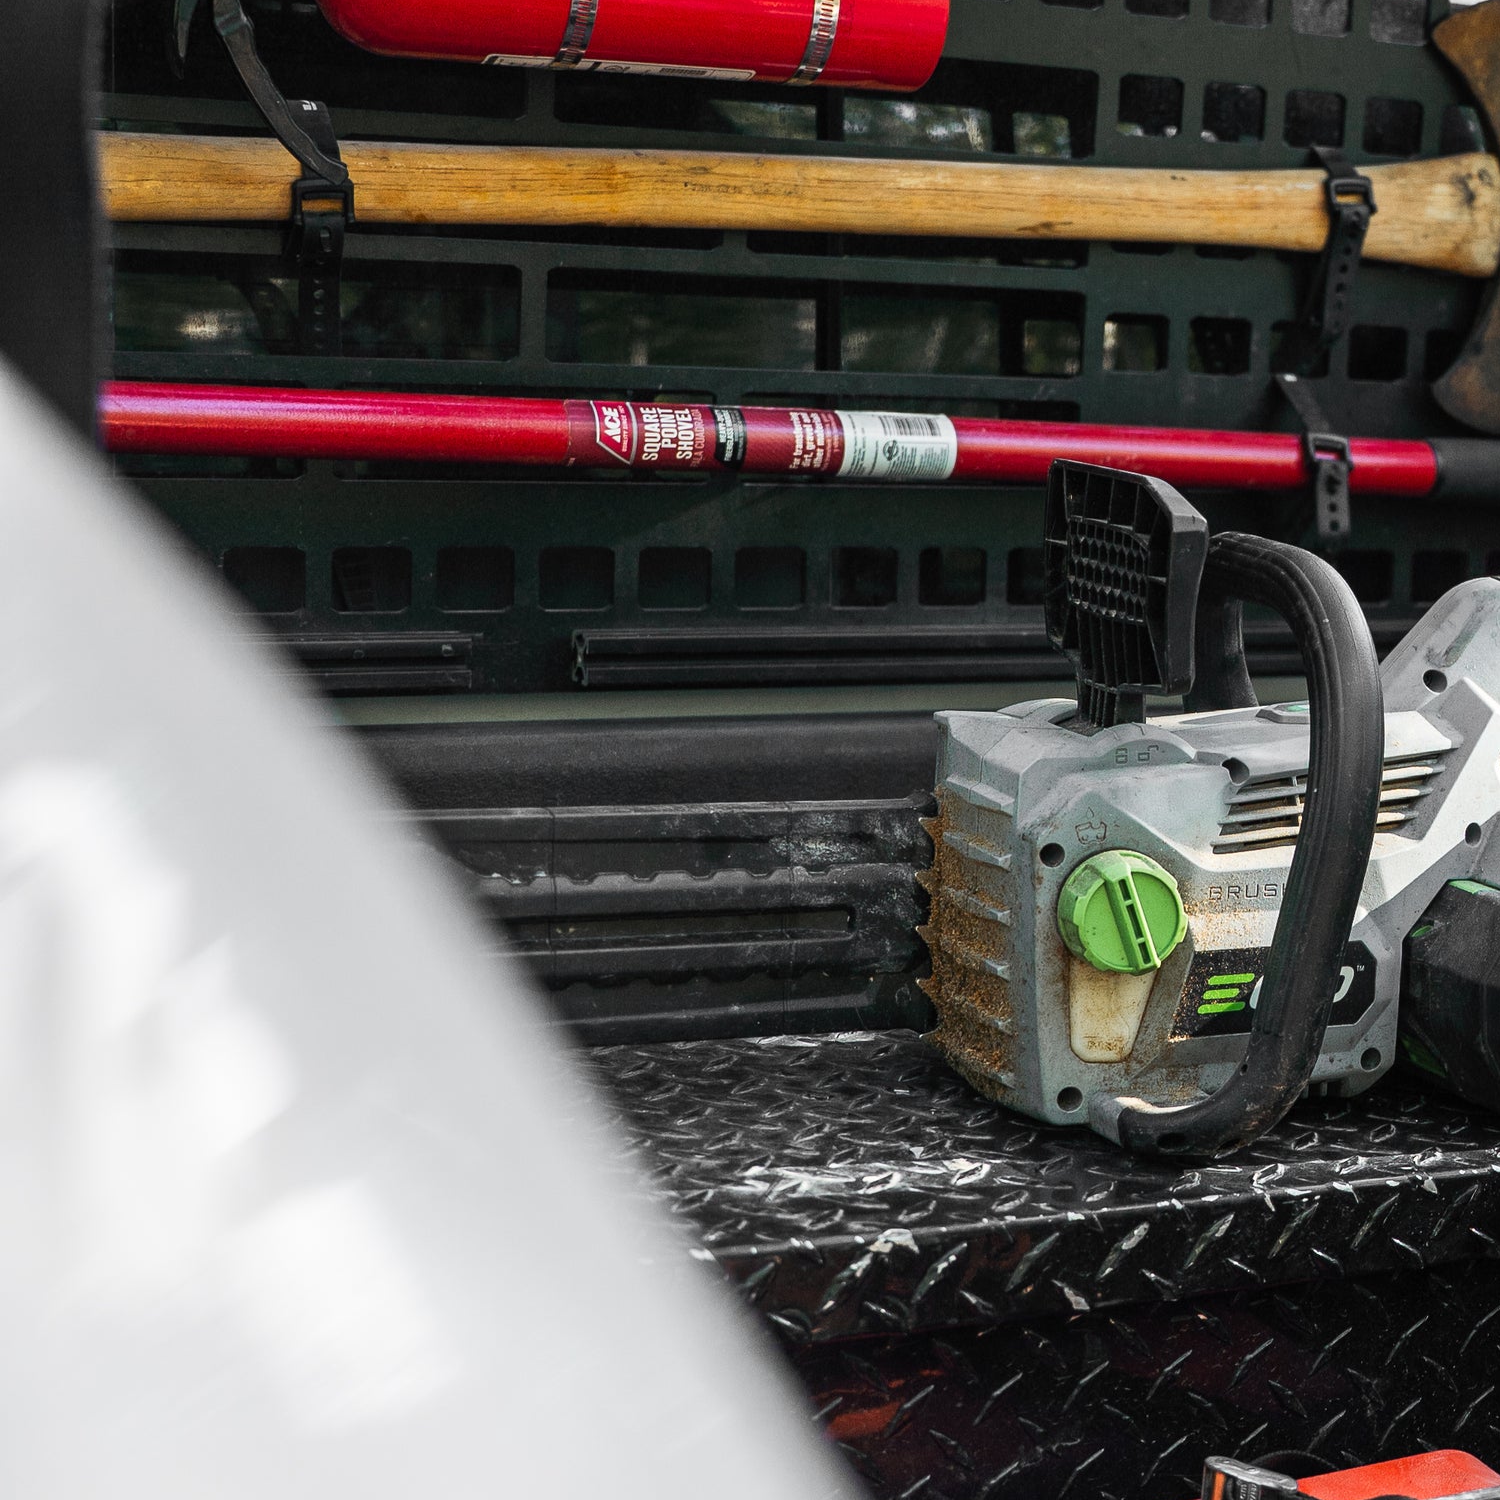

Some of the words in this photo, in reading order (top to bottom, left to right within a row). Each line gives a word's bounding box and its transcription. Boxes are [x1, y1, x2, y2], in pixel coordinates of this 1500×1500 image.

[602, 405, 621, 443] ACE
[639, 406, 660, 461] SQUARE
[657, 407, 679, 448] POINT
[676, 408, 695, 460] SHOVEL
[694, 408, 706, 449] CUADRADA
[1208, 883, 1287, 901] BRUS
